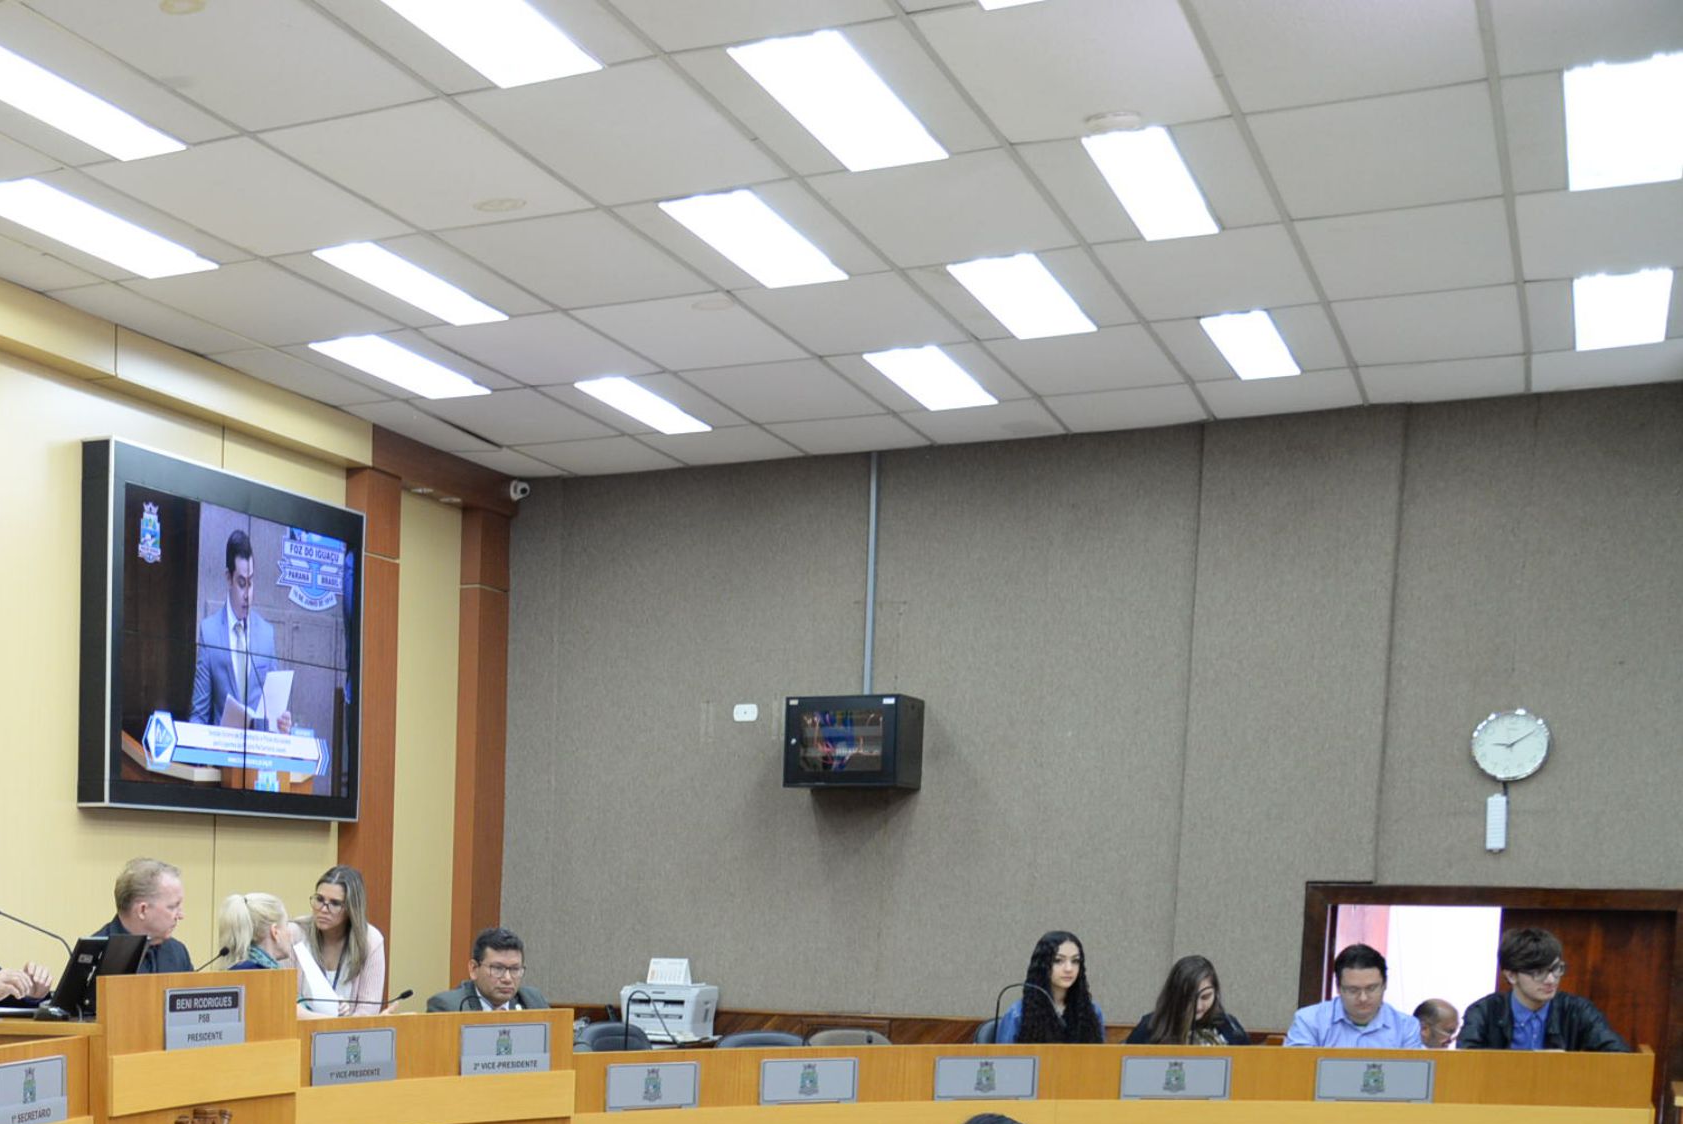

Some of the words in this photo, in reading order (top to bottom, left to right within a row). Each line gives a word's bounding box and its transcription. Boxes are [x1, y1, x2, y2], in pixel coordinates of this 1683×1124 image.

[290, 543, 303, 556] FOZ
[304, 546, 314, 558] DO
[175, 998, 192, 1010] BENI
[193, 996, 233, 1009] RODRIGUES
[187, 1030, 223, 1042] PRESIDENTE
[480, 1059, 538, 1070] VICE-PRESIDENTE
[335, 1068, 381, 1079] VICE-PRESIDENTE
